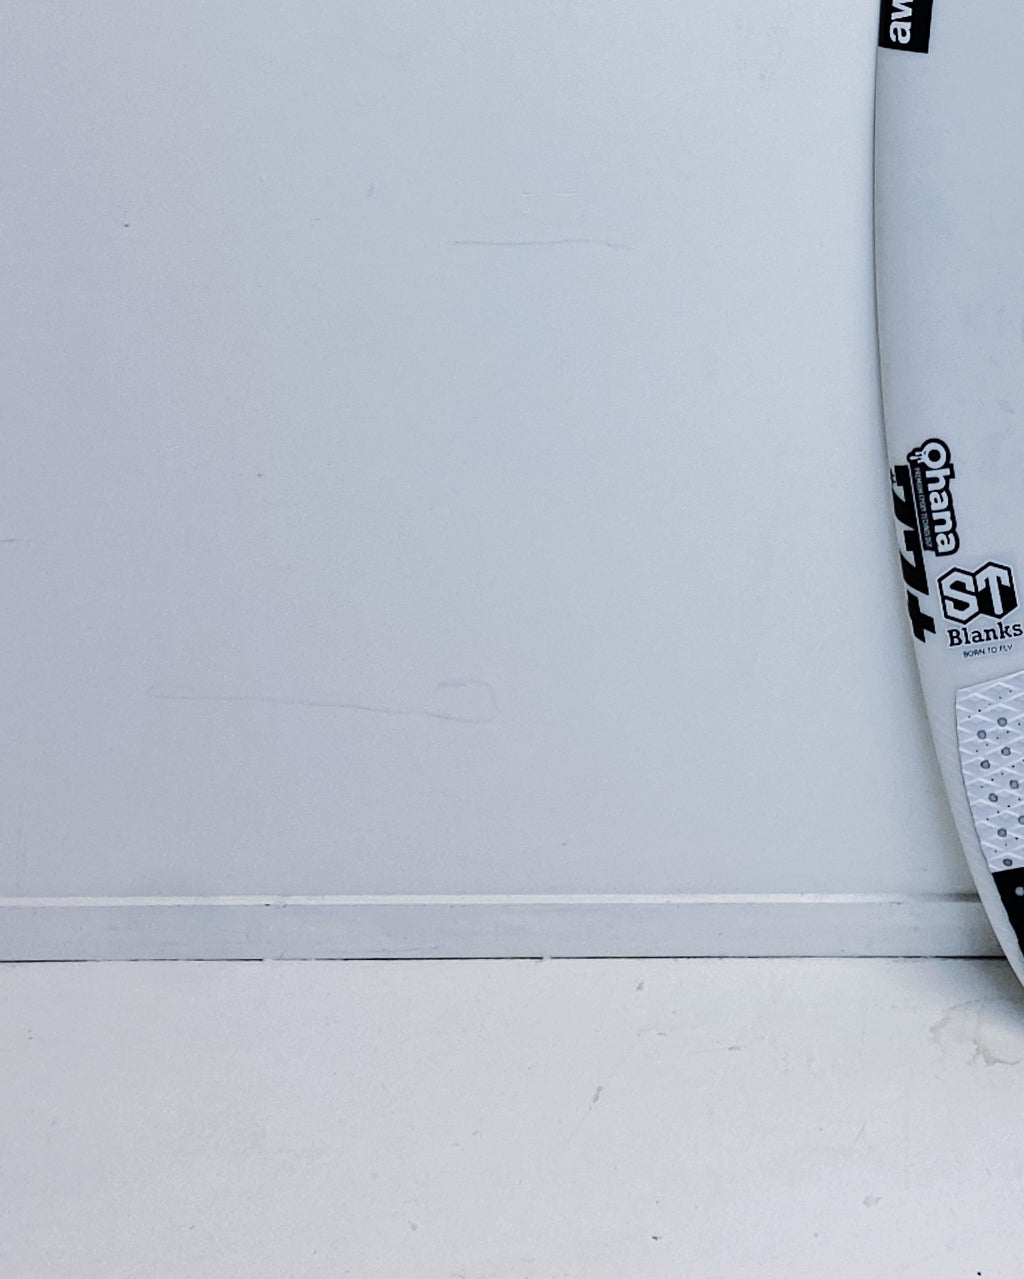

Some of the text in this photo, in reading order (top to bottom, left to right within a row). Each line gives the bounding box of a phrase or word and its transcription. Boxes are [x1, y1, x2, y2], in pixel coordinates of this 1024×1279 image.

[947, 621, 1023, 647] Blanks
[963, 649, 985, 658] BORN
[999, 644, 1013, 652] FLY
